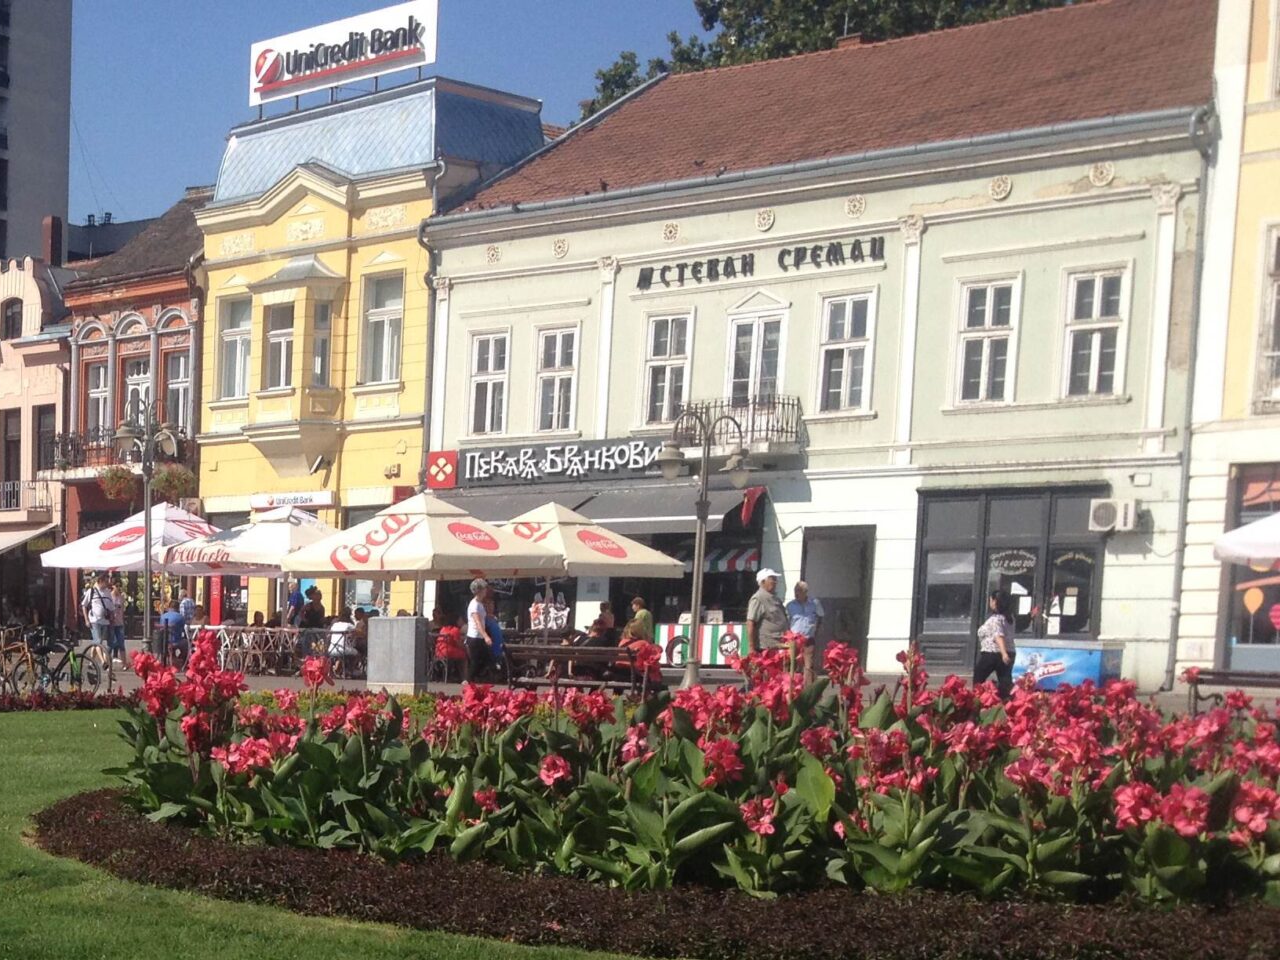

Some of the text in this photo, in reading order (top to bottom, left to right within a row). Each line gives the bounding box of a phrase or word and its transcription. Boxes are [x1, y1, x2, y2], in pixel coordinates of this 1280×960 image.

[286, 16, 425, 75] UniCredit Bank
[543, 441, 665, 476] БРАНКОВИ
[275, 495, 314, 505] UniCredit Bank
